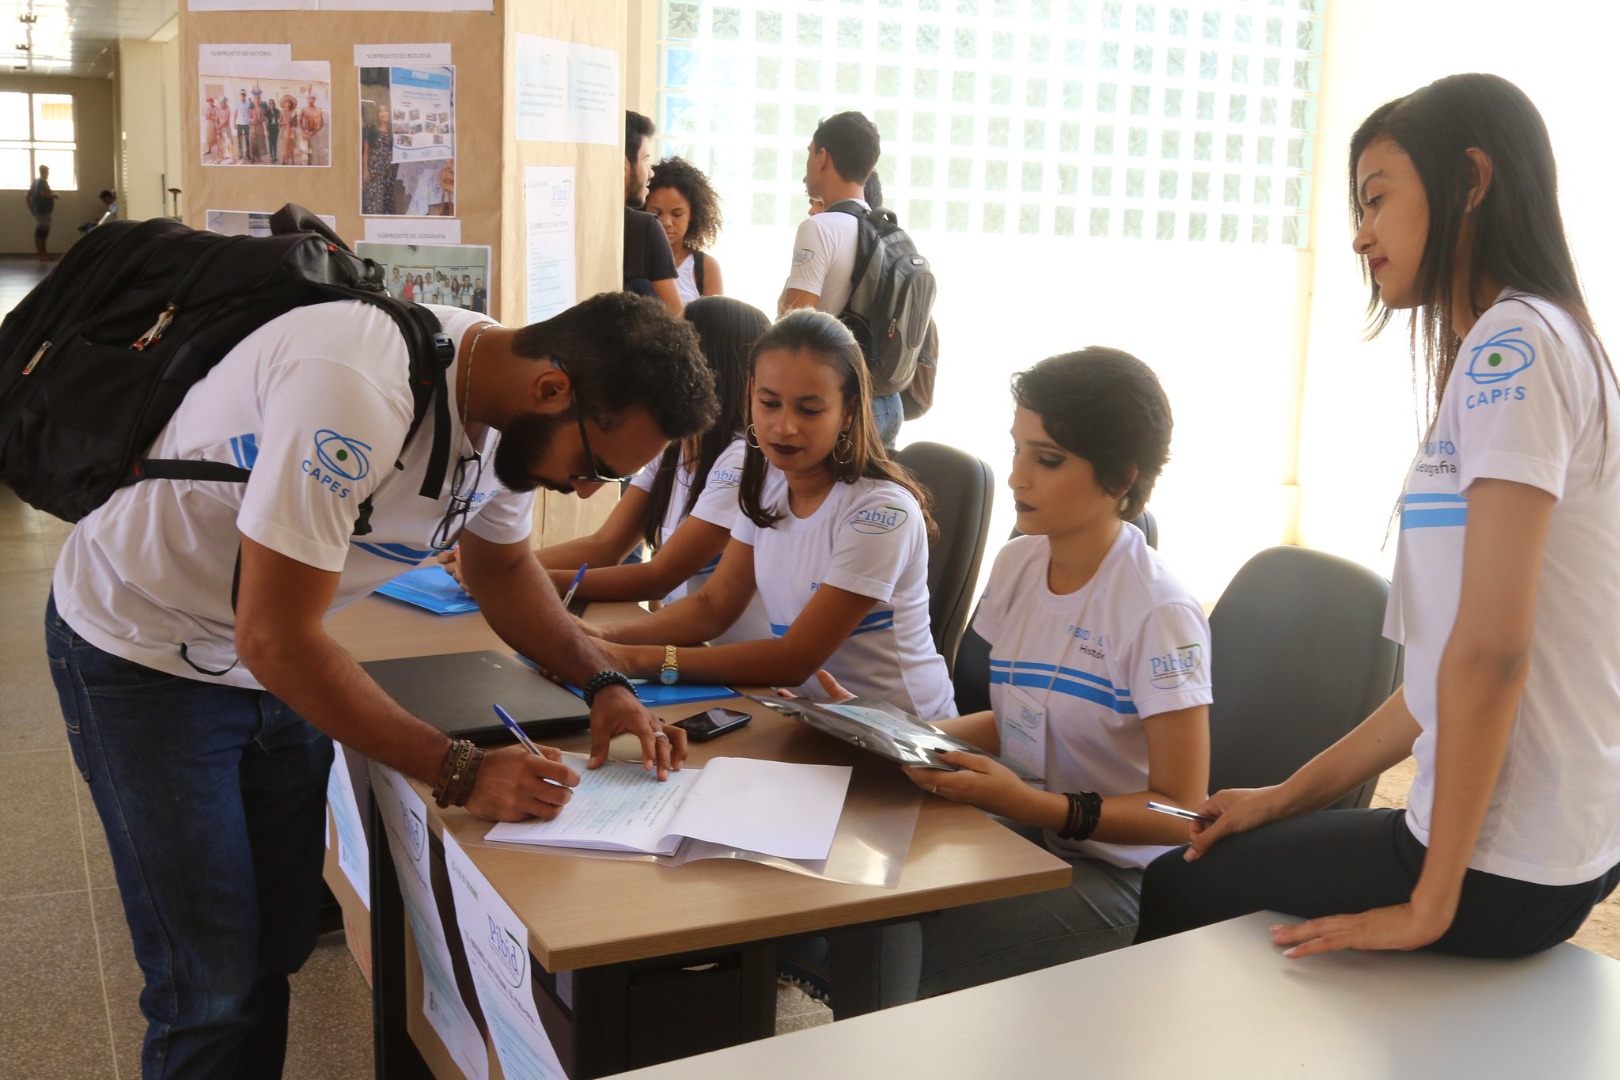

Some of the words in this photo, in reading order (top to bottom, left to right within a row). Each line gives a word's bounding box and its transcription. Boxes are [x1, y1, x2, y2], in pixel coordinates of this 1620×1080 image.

[1466, 386, 1527, 409] CAPES
[301, 459, 351, 499] CAPES
[1149, 650, 1195, 674] Pibid
[486, 912, 520, 976] Pibid
